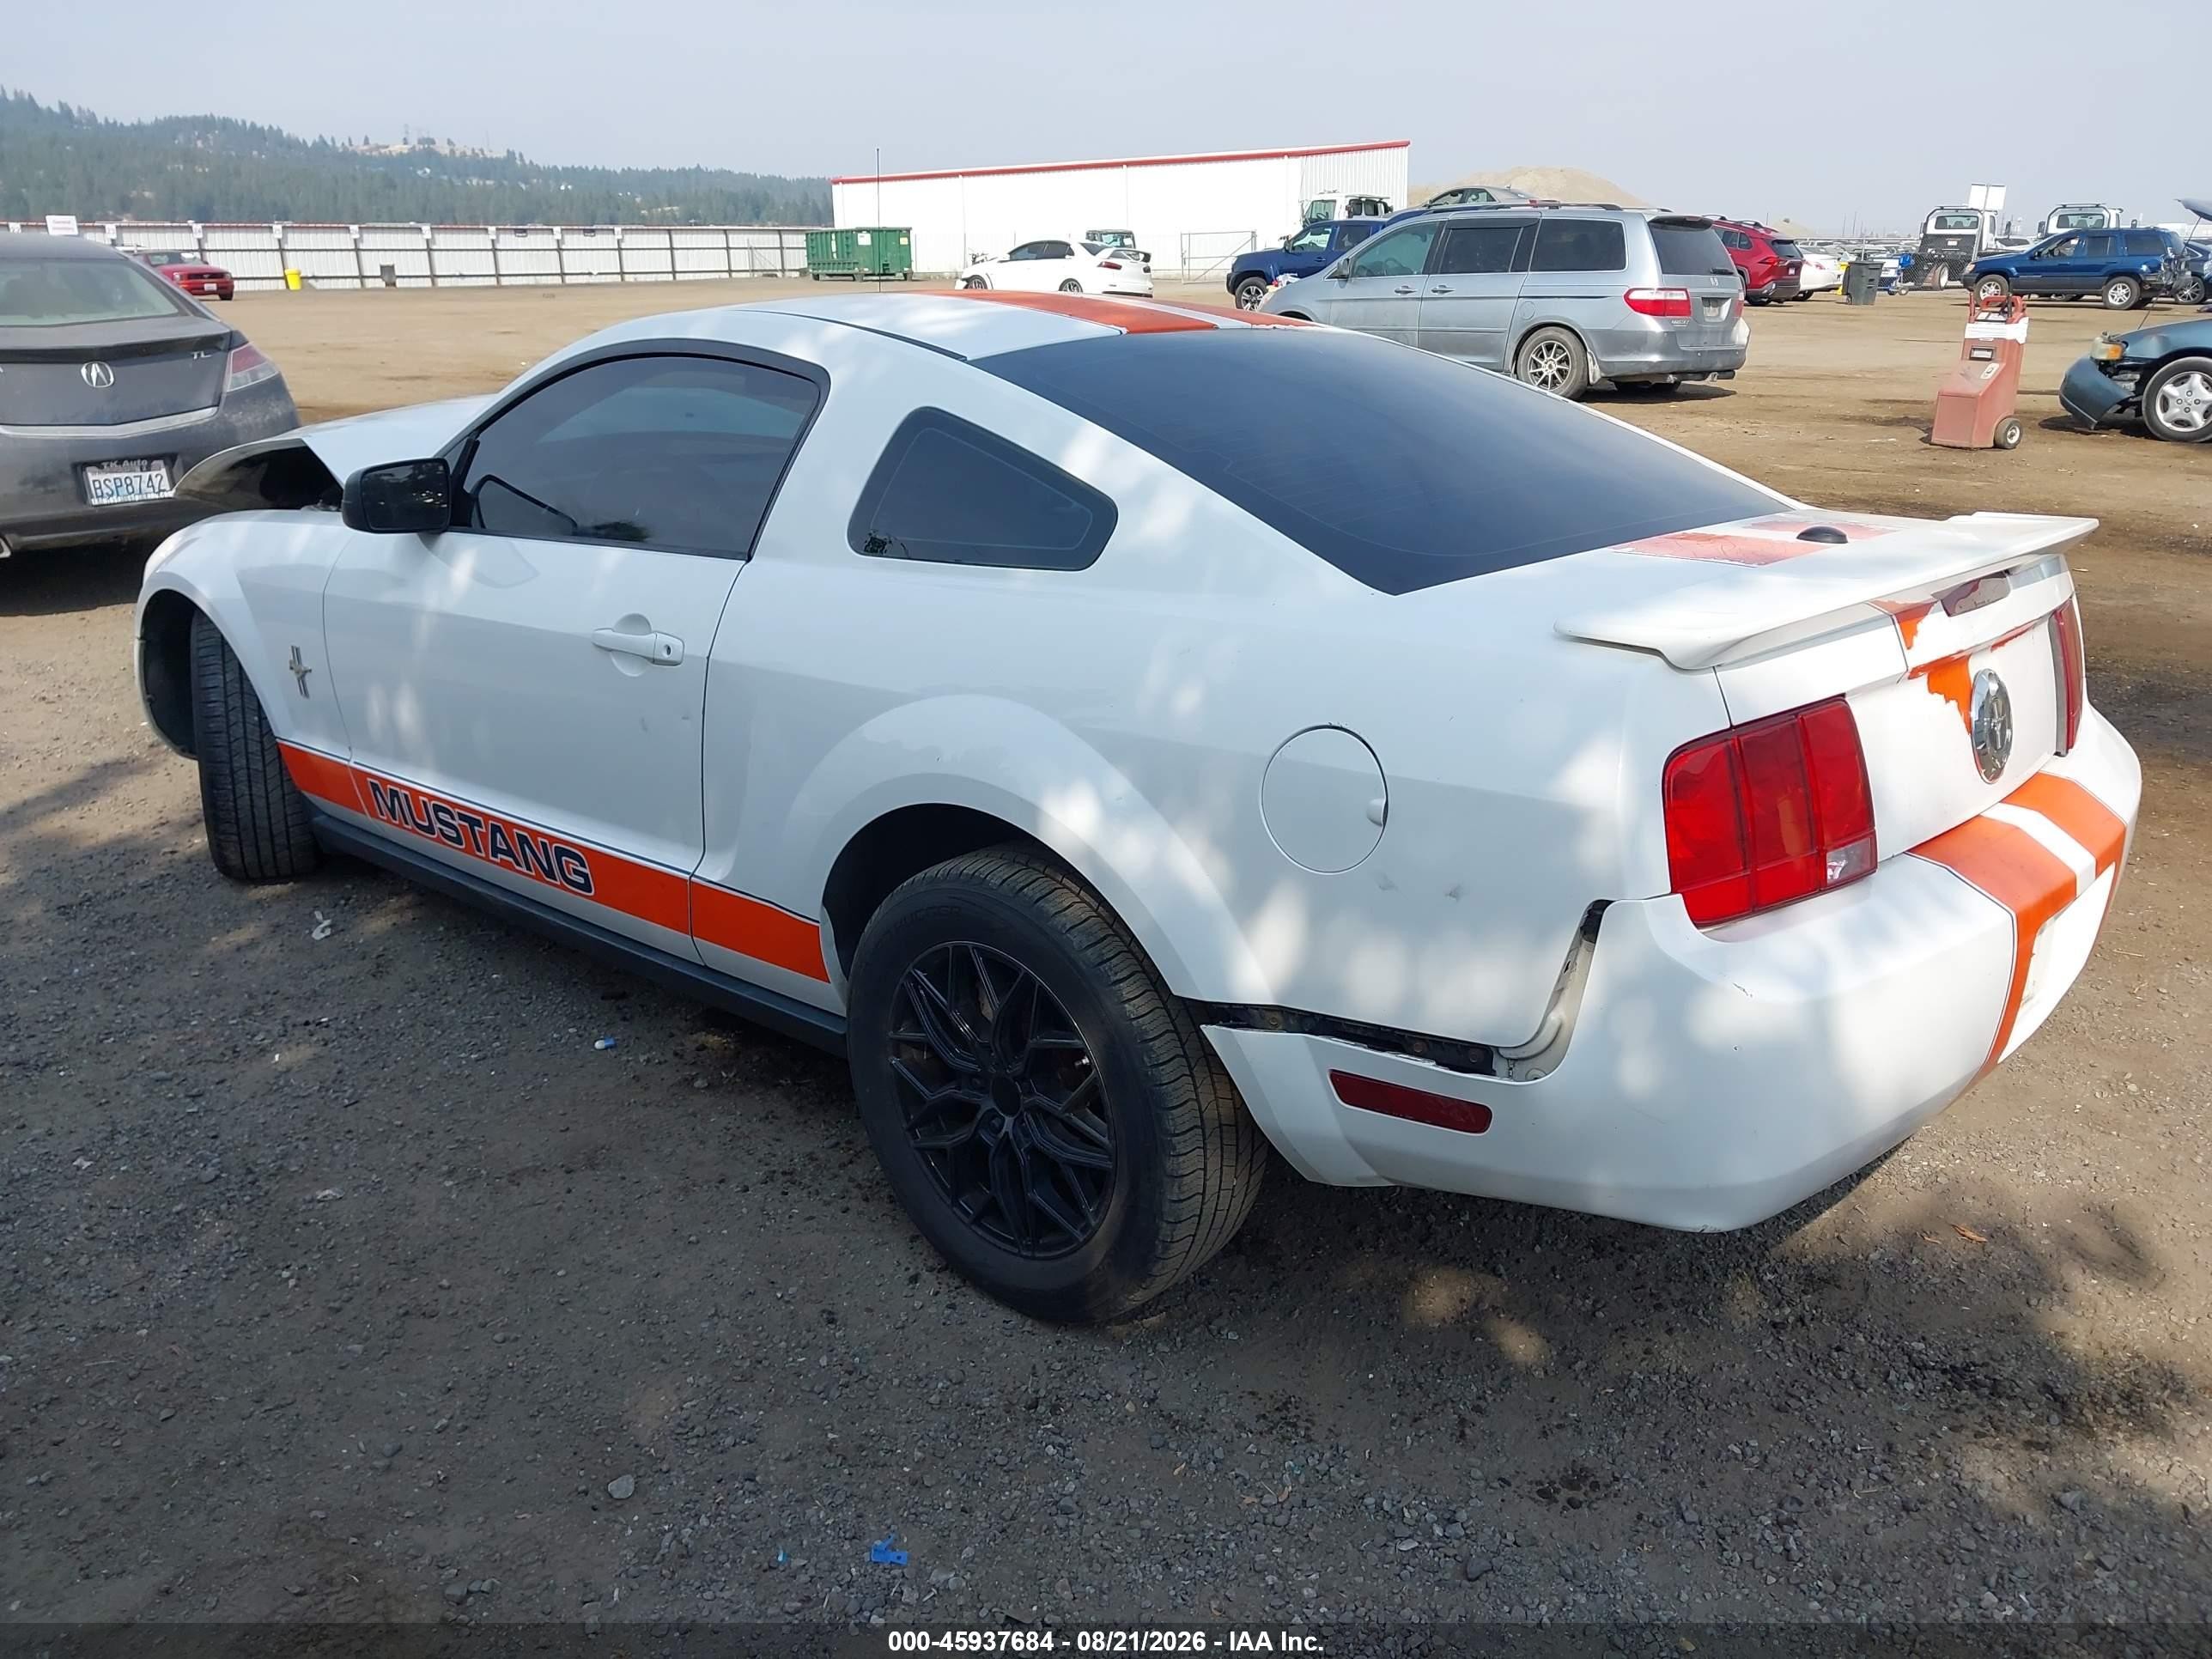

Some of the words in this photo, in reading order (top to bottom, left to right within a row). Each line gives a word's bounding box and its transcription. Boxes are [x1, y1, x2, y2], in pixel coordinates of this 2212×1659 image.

[190, 350, 212, 360] TL
[92, 473, 168, 499] BSP8742
[367, 777, 594, 896] MUSTANG
